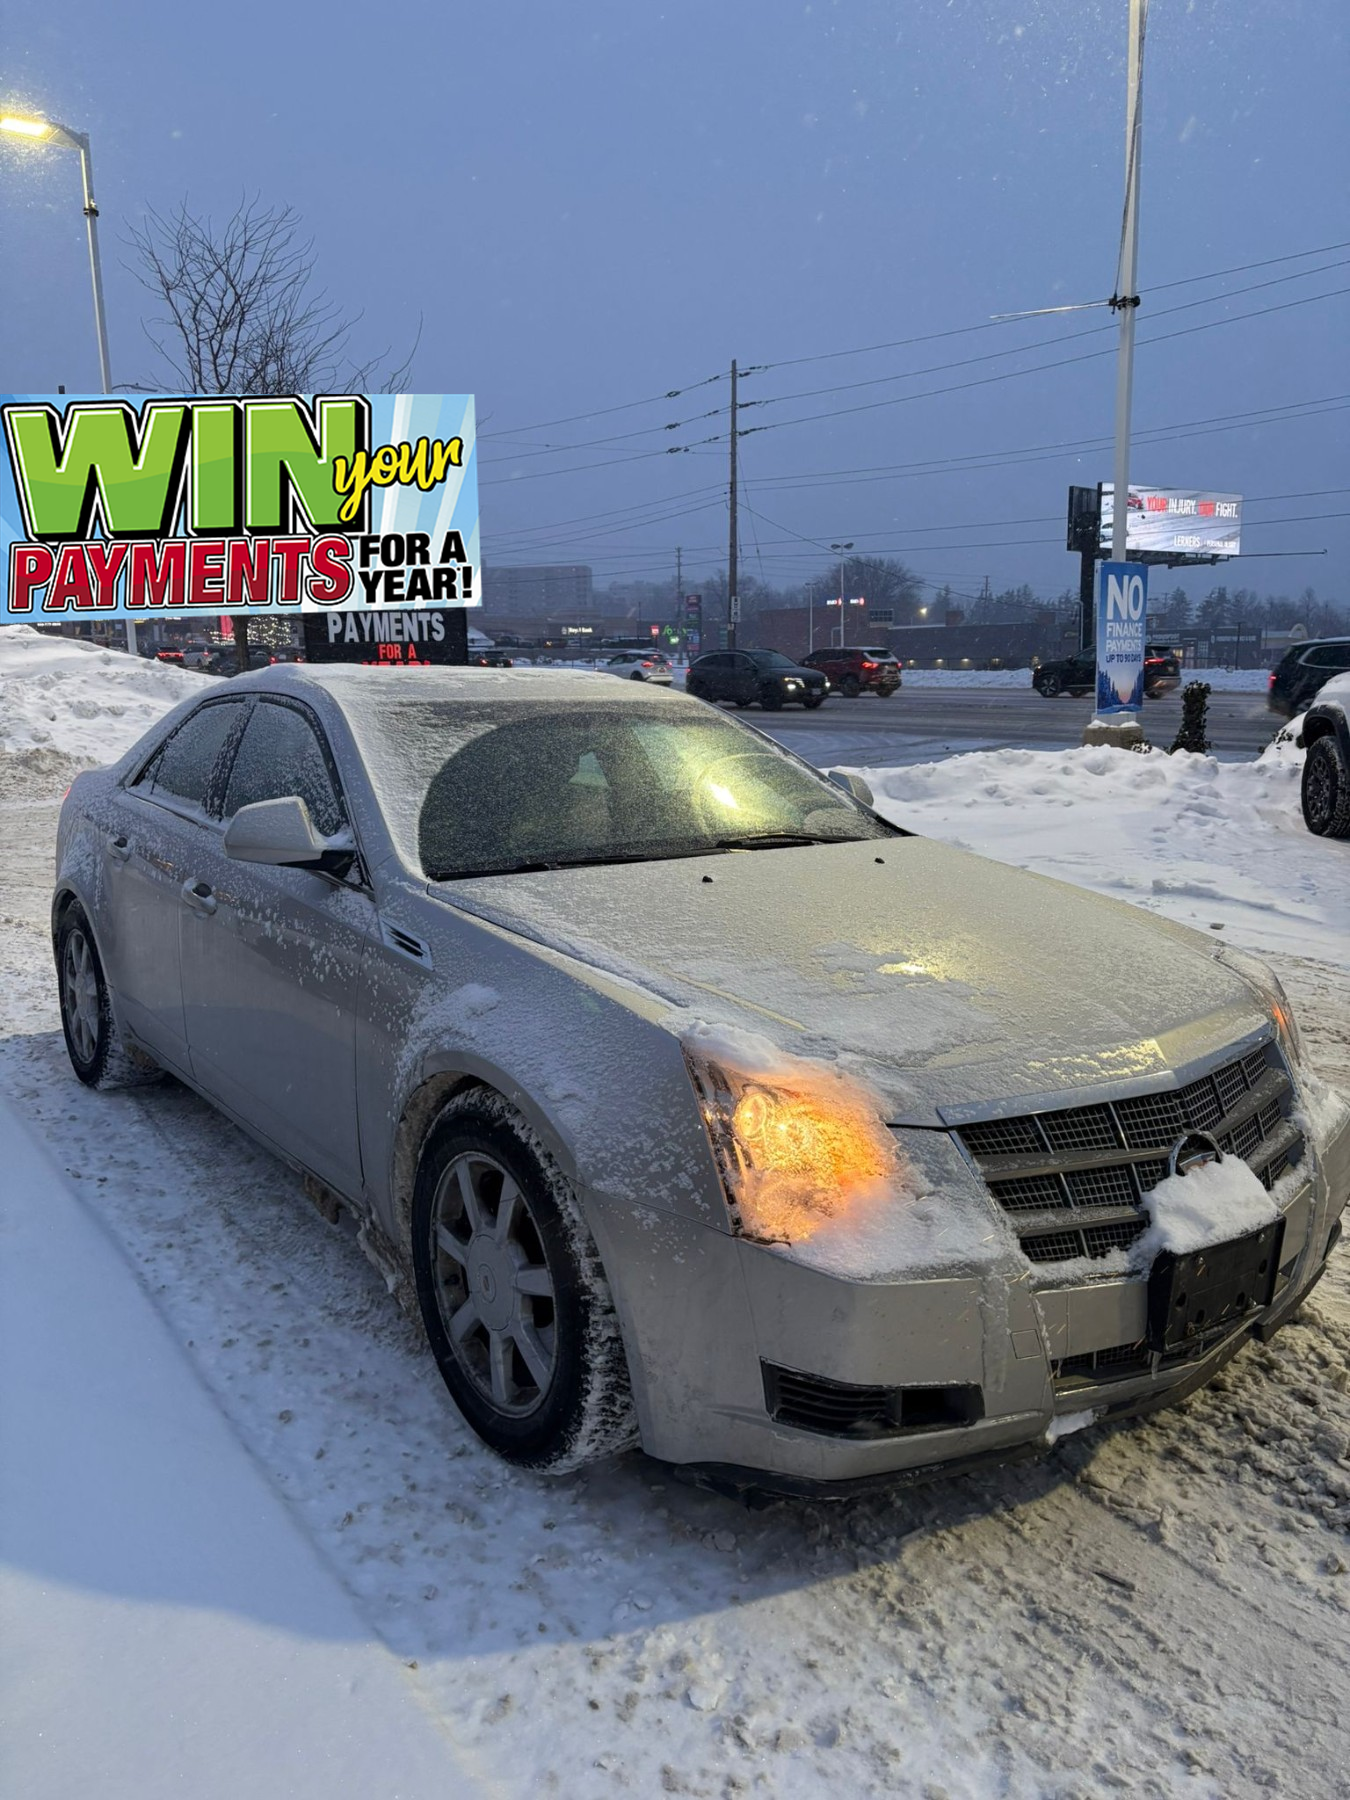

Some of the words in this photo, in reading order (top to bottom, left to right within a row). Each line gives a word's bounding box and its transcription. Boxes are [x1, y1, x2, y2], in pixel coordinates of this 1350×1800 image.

[1168, 498, 1197, 515] INJURY.
[1215, 503, 1238, 518] FIGHT.
[1107, 574, 1143, 621] NO
[327, 612, 445, 643] PAYMENTS
[1106, 622, 1143, 637] FINANCE
[379, 644, 402, 659] FOR
[408, 643, 417, 659] A
[1105, 639, 1142, 653] PAYMENTS
[1106, 654, 1115, 663] UP
[1116, 654, 1124, 663] TO
